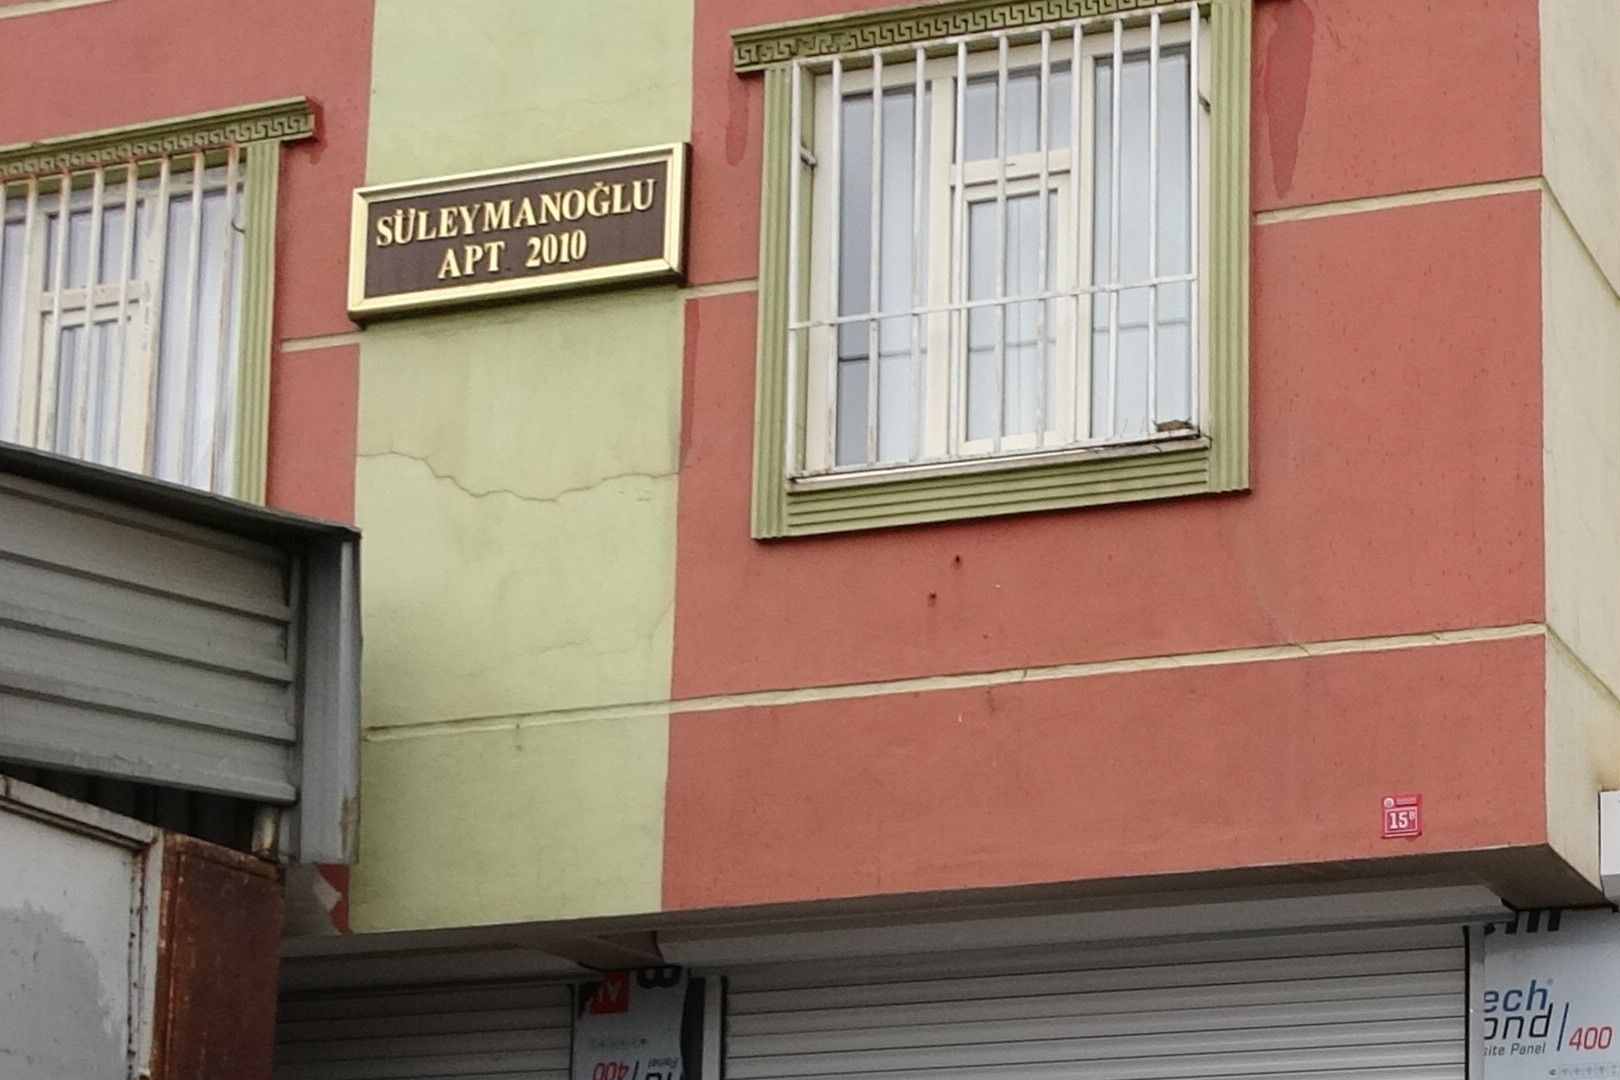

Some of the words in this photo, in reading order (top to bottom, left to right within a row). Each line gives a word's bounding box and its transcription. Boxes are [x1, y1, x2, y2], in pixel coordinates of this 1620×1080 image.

[375, 178, 656, 247] SÜLEYMANOĞLU
[437, 240, 505, 280] APT
[525, 229, 588, 269] 2010
[1510, 1042, 1547, 1056] Panel
[1569, 1026, 1612, 1051] 400
